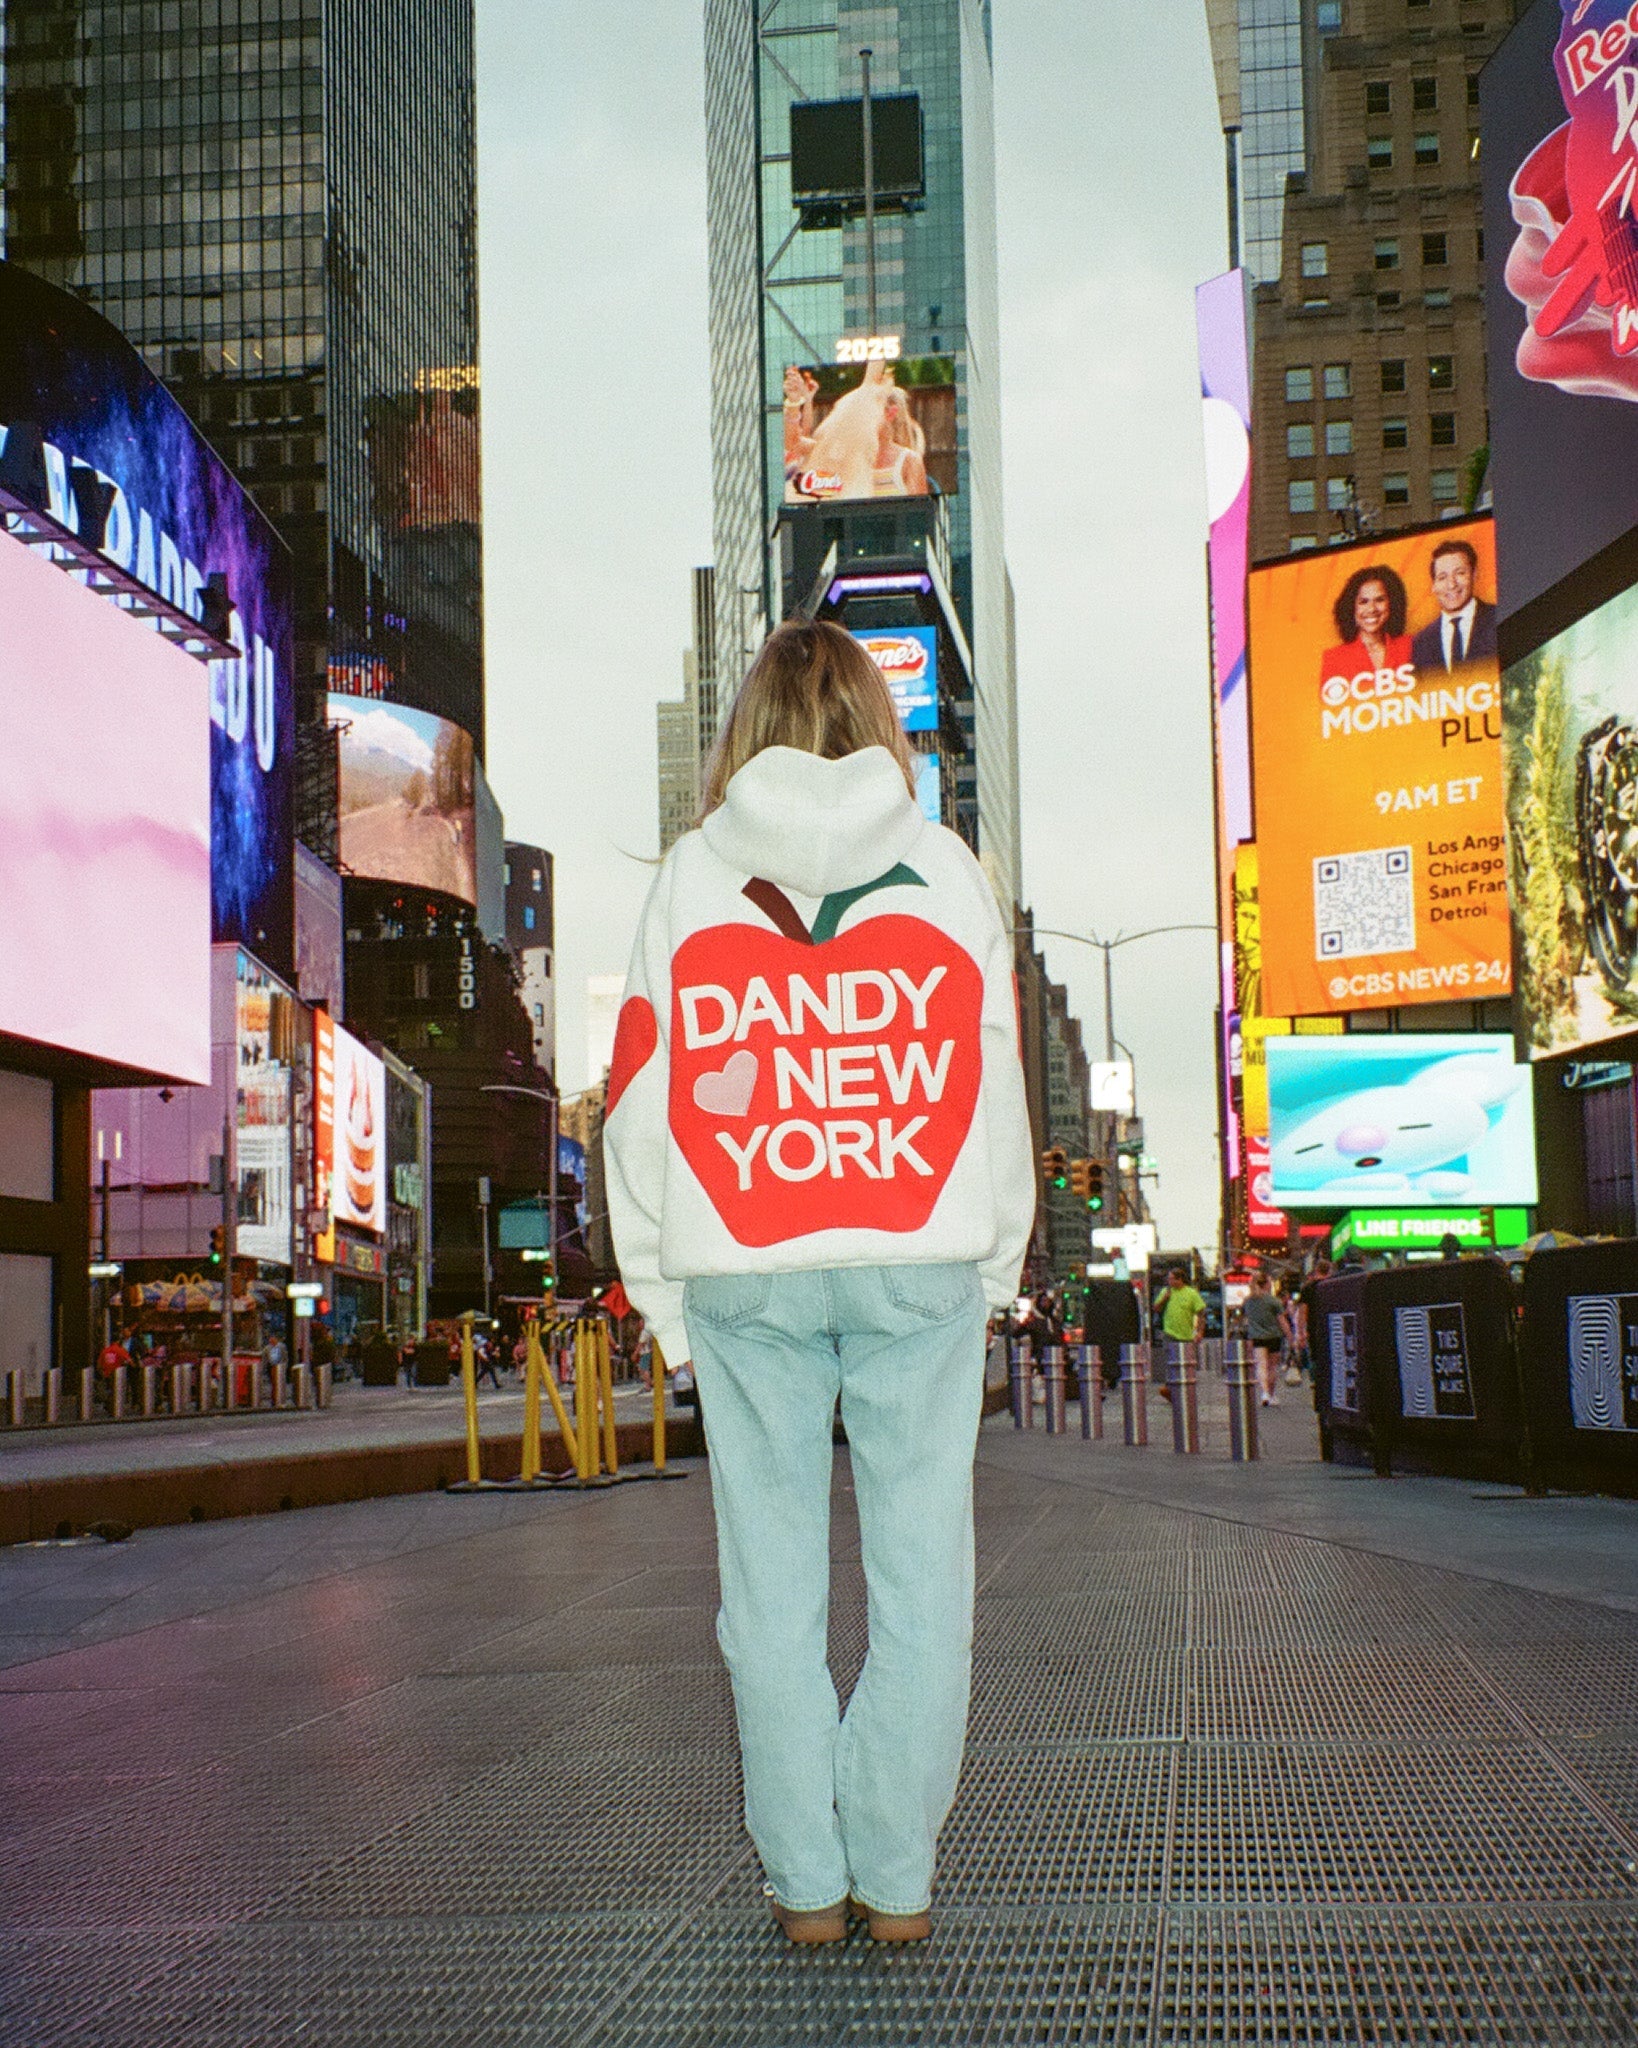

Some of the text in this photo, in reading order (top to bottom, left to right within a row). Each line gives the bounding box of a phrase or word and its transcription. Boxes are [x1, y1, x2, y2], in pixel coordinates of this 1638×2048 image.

[835, 336, 901, 361] 2025
[1350, 663, 1416, 701] CBS
[1375, 775, 1483, 815] 9AM ET
[1428, 841, 1459, 856] Los
[1428, 858, 1504, 878] Chicago
[1429, 885, 1462, 901] San
[458, 938, 476, 1010] 1500
[1349, 971, 1394, 996] CBS
[1397, 962, 1470, 990] NEWS
[678, 966, 948, 1051] DANDY
[772, 1039, 956, 1110] NEW
[714, 1115, 935, 1192] YORK
[1355, 1219, 1398, 1238] LINE
[1401, 1218, 1482, 1238] FRIENDS
